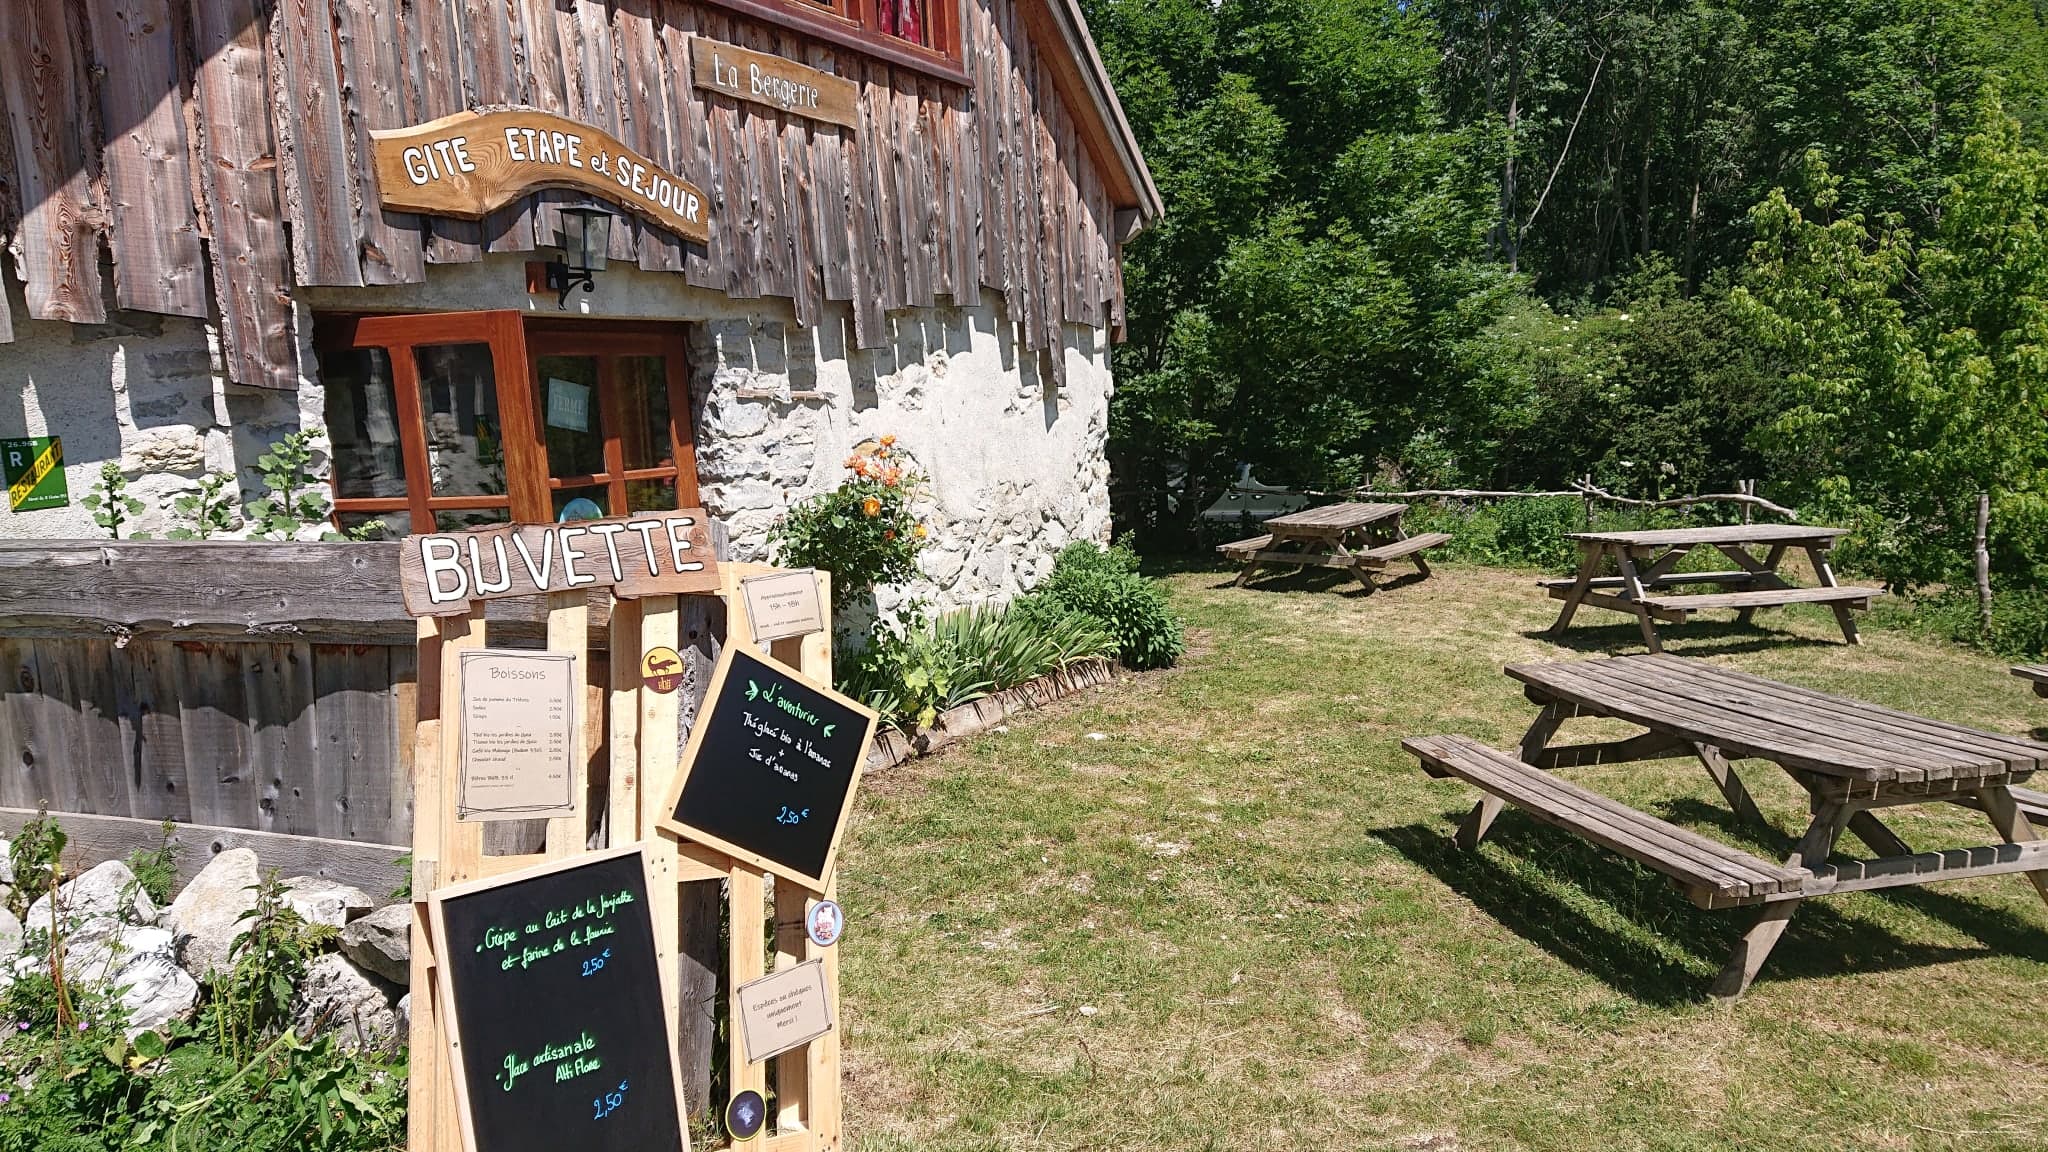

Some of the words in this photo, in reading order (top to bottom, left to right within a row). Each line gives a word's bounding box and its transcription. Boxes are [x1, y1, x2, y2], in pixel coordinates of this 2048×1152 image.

[713, 53, 738, 88] La
[750, 62, 818, 109] Bergerie
[403, 136, 476, 186] GITE
[504, 126, 583, 168] ETAPE
[590, 155, 612, 178] et
[615, 155, 700, 224] SEJOUR
[9, 451, 23, 467] R
[11, 440, 63, 507] RESTAURANT
[420, 516, 704, 604] BUVETTE
[488, 666, 546, 680] Boissons
[762, 682, 819, 726] L'aventurier
[780, 729, 792, 744] bio
[525, 923, 539, 934] au
[545, 910, 568, 929] lait
[572, 906, 584, 920] de
[586, 899, 596, 914] la
[501, 955, 520, 970] et
[521, 946, 550, 969] farine
[553, 938, 565, 953] de
[533, 1032, 595, 1067] artisanale
